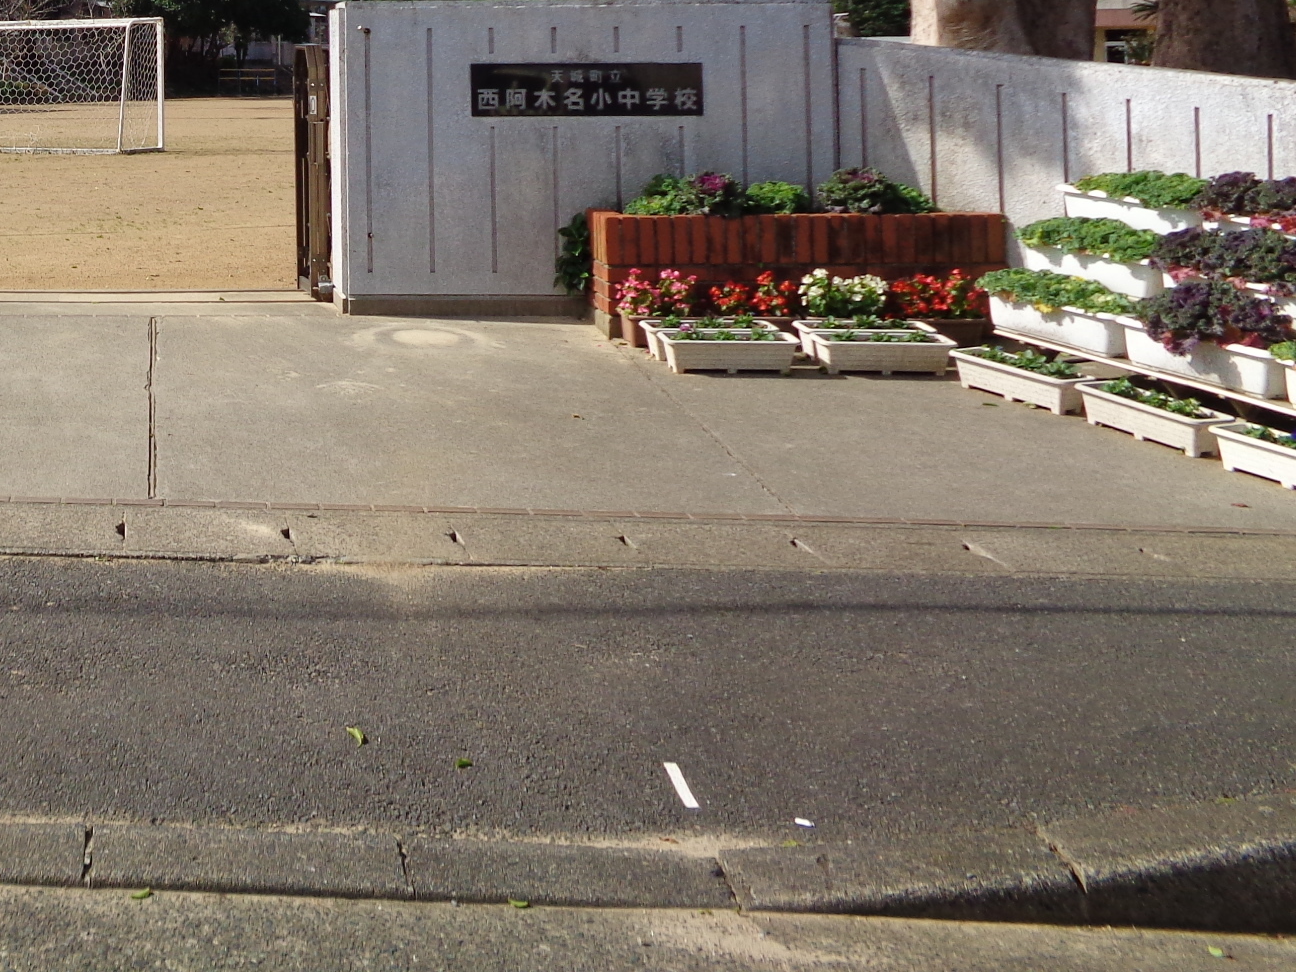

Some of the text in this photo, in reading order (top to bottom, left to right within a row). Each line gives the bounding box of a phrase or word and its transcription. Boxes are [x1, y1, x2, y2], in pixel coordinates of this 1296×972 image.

[551, 70, 623, 83] 天城町立
[478, 88, 698, 111] 西阿木名小中学校
